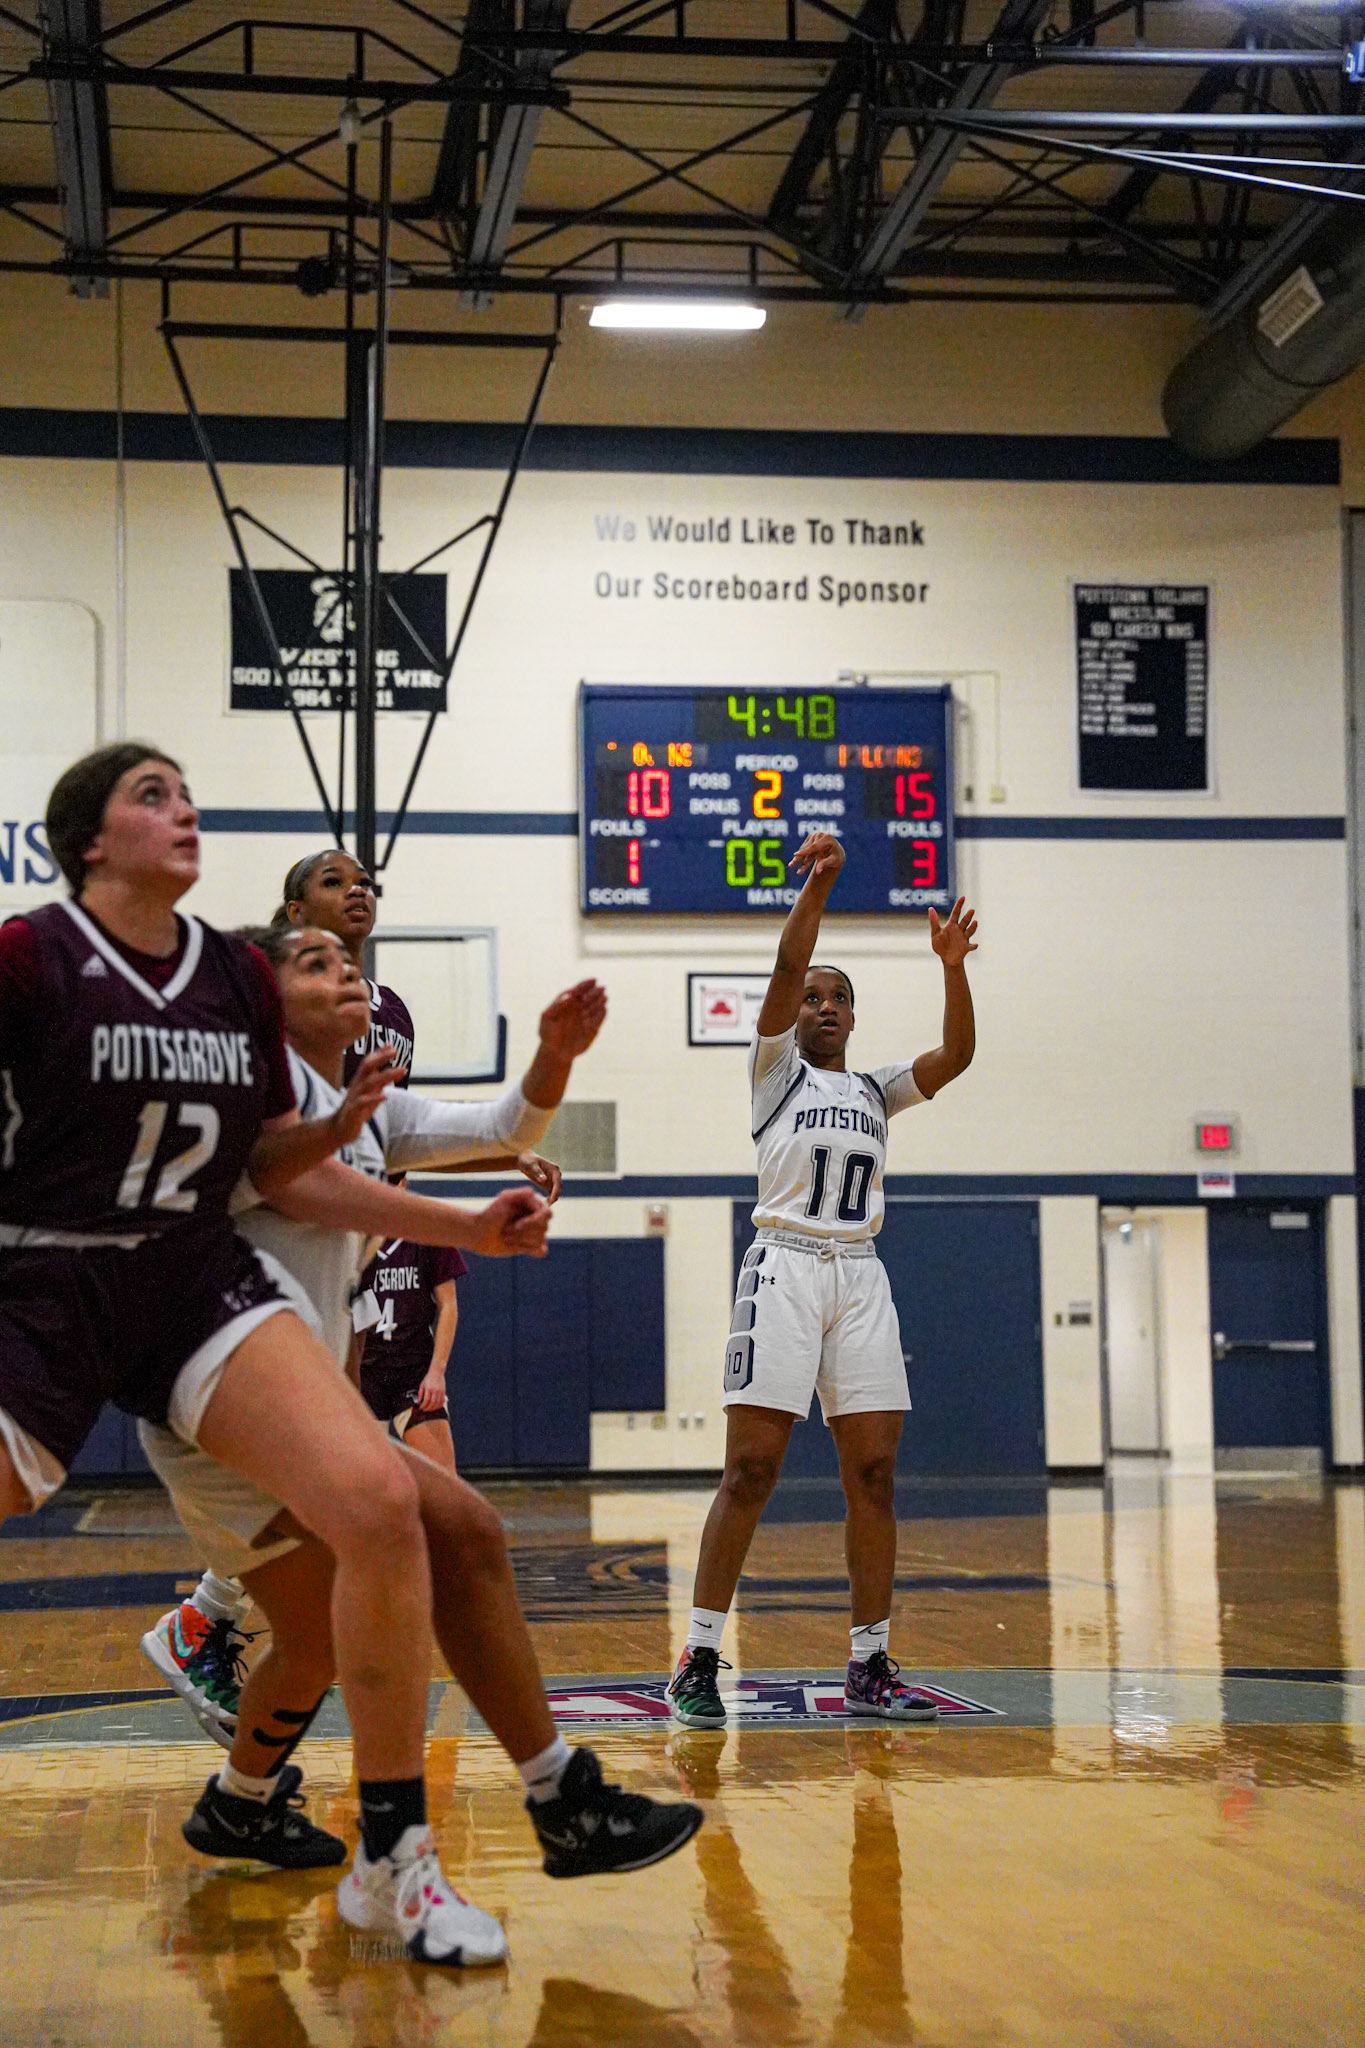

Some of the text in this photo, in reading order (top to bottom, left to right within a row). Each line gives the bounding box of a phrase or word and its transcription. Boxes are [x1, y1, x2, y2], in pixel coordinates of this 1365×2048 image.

[593, 516, 924, 546] We Would Like To Thank
[594, 571, 930, 606] Our Scoreboard Sponsor
[728, 695, 835, 739] 4:48
[735, 754, 798, 771] PERIOD
[628, 768, 671, 818] 10
[689, 772, 731, 790] POSS
[753, 769, 782, 818] 2
[803, 773, 845, 791] POSS
[895, 772, 936, 818] 15
[689, 798, 740, 815] BONUS
[794, 798, 845, 816] BONUS
[590, 819, 647, 836] FOULS
[722, 820, 788, 836] PLAYER
[887, 821, 943, 838] FOULS
[628, 839, 641, 885] 1
[726, 839, 786, 887] 05
[912, 840, 937, 887] 3
[589, 888, 650, 905] SCORE
[747, 888, 802, 906] MATC
[889, 889, 949, 906] SCORE
[91, 1024, 254, 1087] POTTSGROVE
[793, 1106, 885, 1149] POTTSTOWN
[116, 1101, 220, 1214] 12
[804, 1144, 878, 1225] 10
[376, 1299, 398, 1341] 4
[727, 1351, 743, 1376] 10
